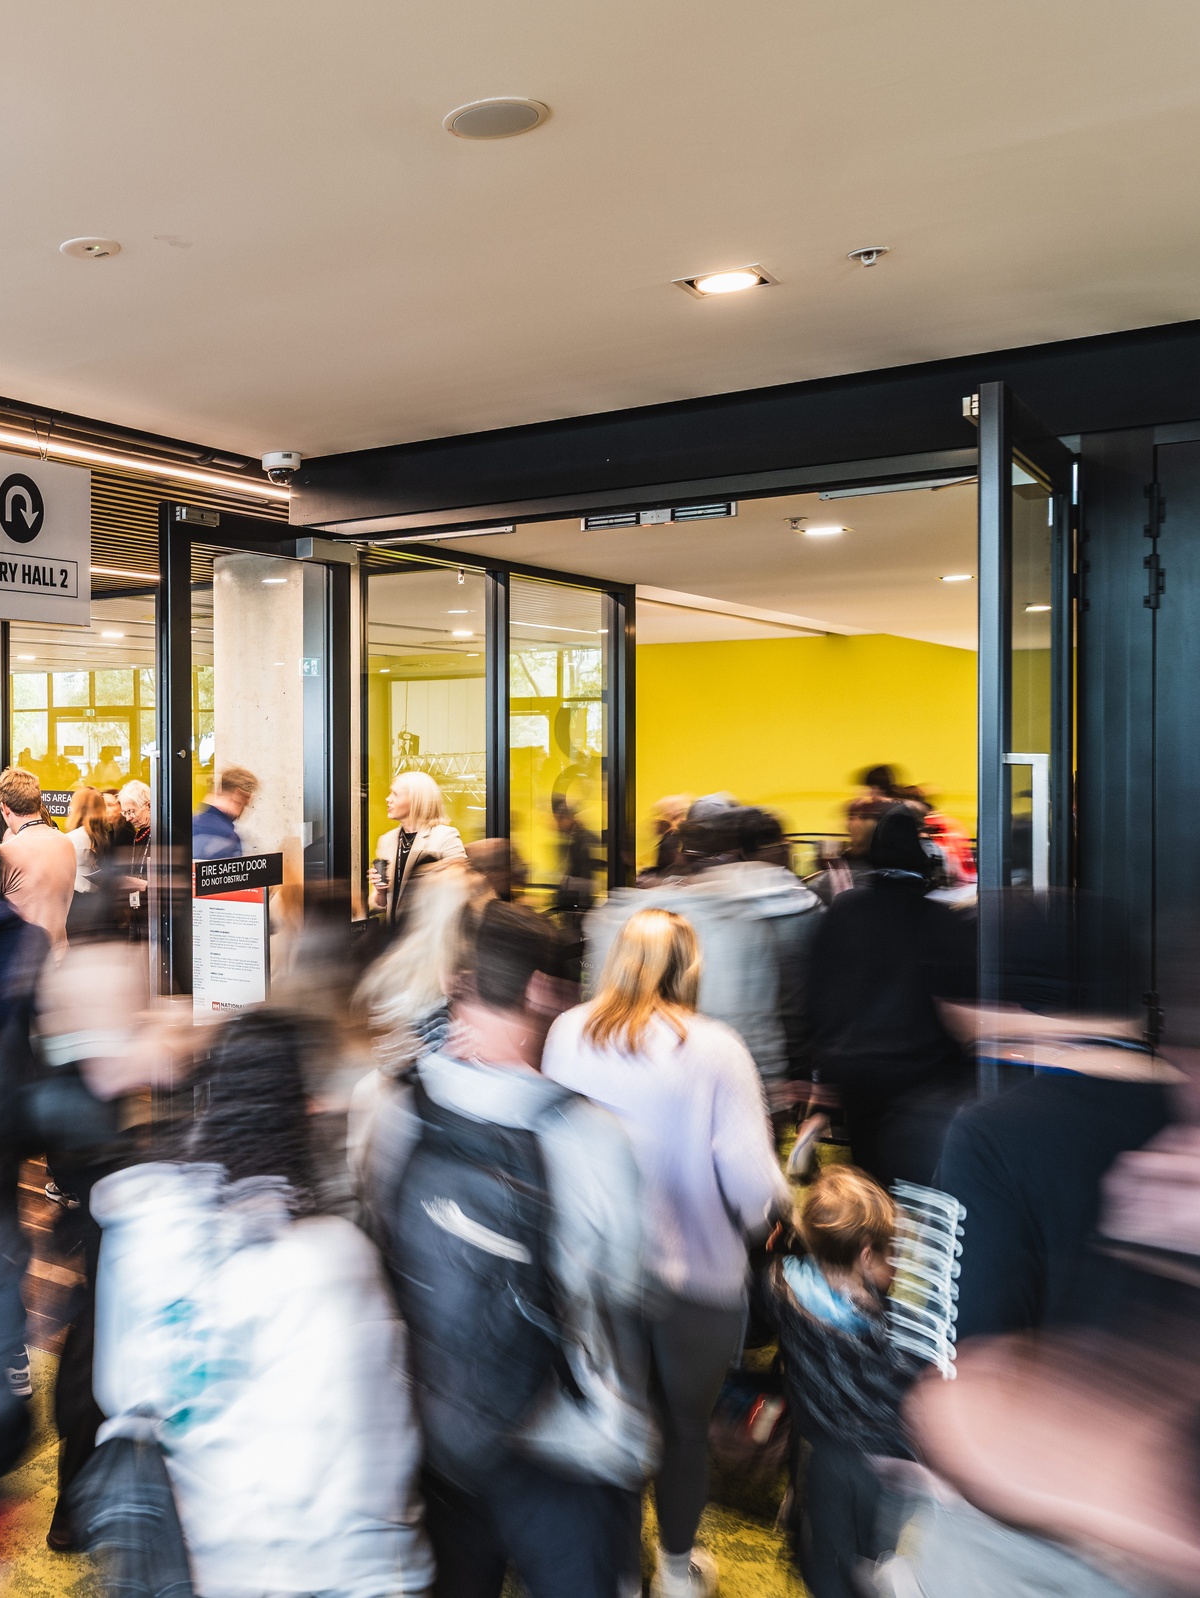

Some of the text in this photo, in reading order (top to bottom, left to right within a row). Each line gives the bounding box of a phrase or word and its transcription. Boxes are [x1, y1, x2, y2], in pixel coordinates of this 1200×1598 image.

[21, 563, 58, 588] HALL
[60, 568, 69, 589] 2
[41, 793, 72, 803] HIS AREA
[201, 859, 267, 877] FIRE SAFETY DOOR
[201, 874, 249, 887] DO NOT OBSTRUCT
